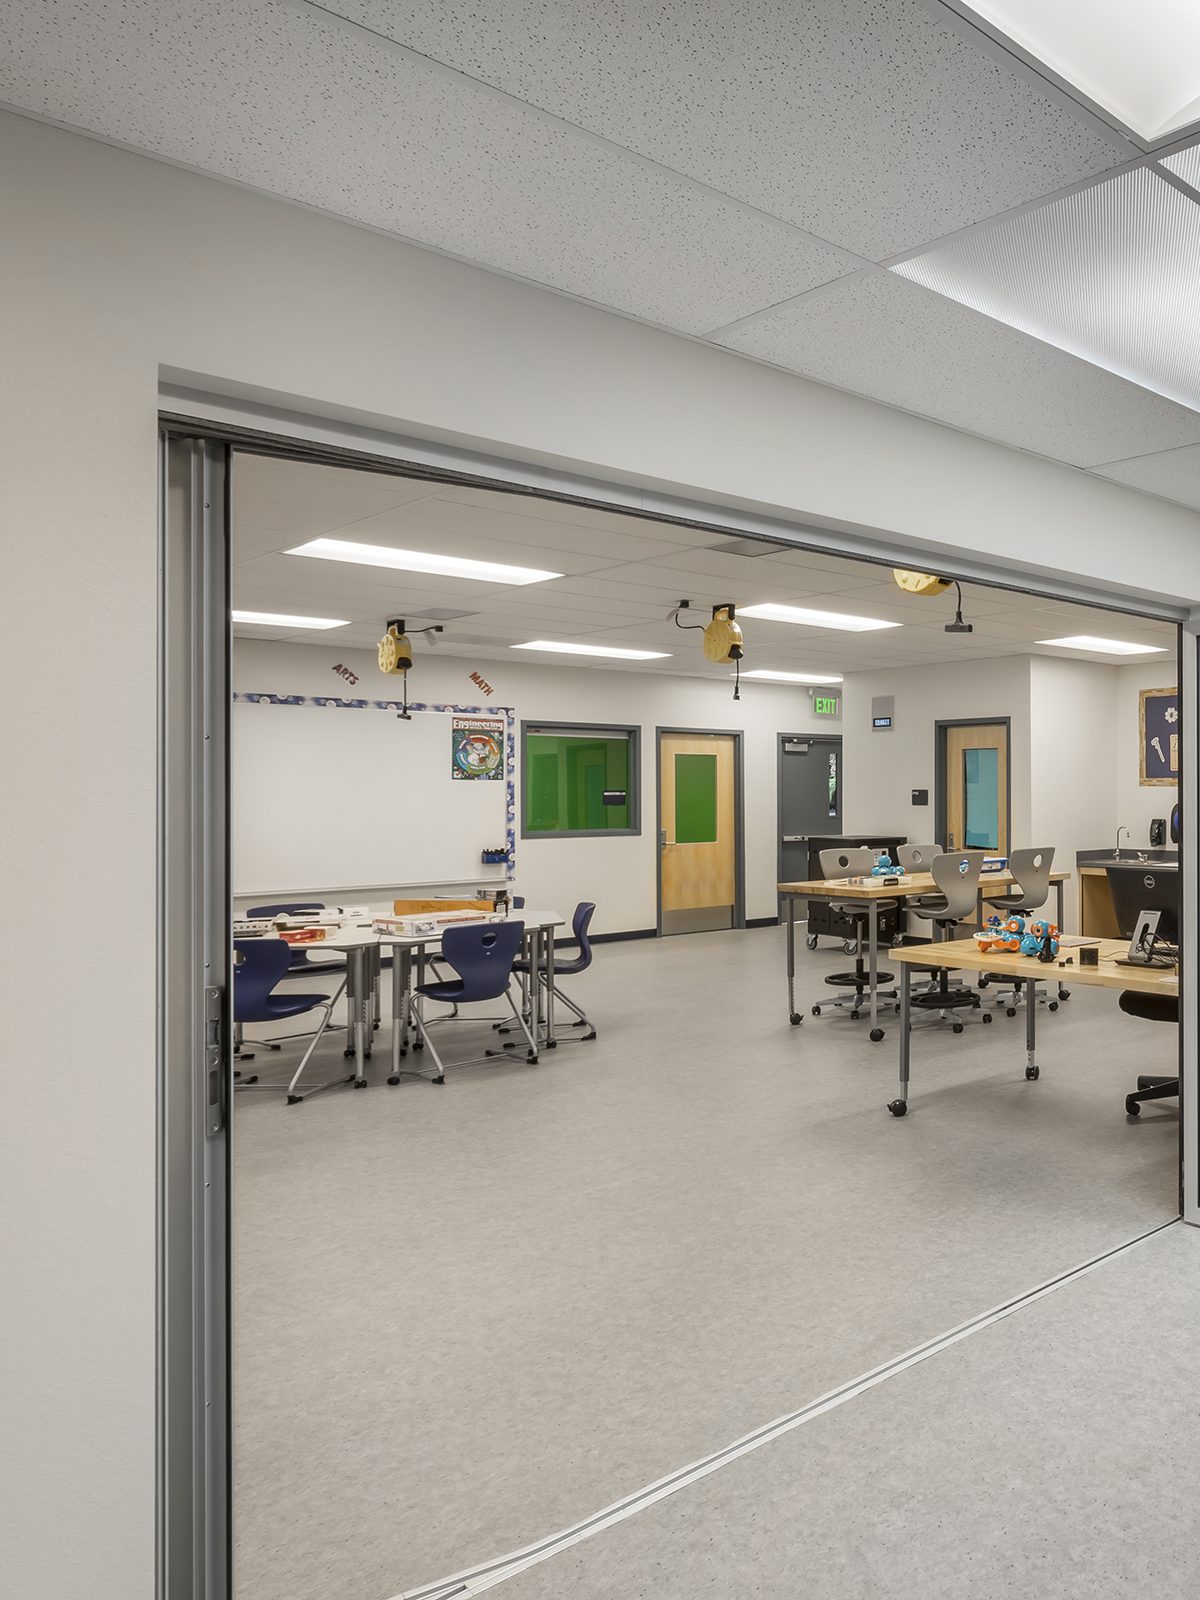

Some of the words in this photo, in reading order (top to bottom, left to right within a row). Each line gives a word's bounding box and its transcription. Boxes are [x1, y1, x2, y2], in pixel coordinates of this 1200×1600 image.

[332, 663, 359, 686] ARTS
[469, 671, 494, 697] MATH
[815, 697, 836, 714] EXIT
[453, 719, 503, 731] Engineering
